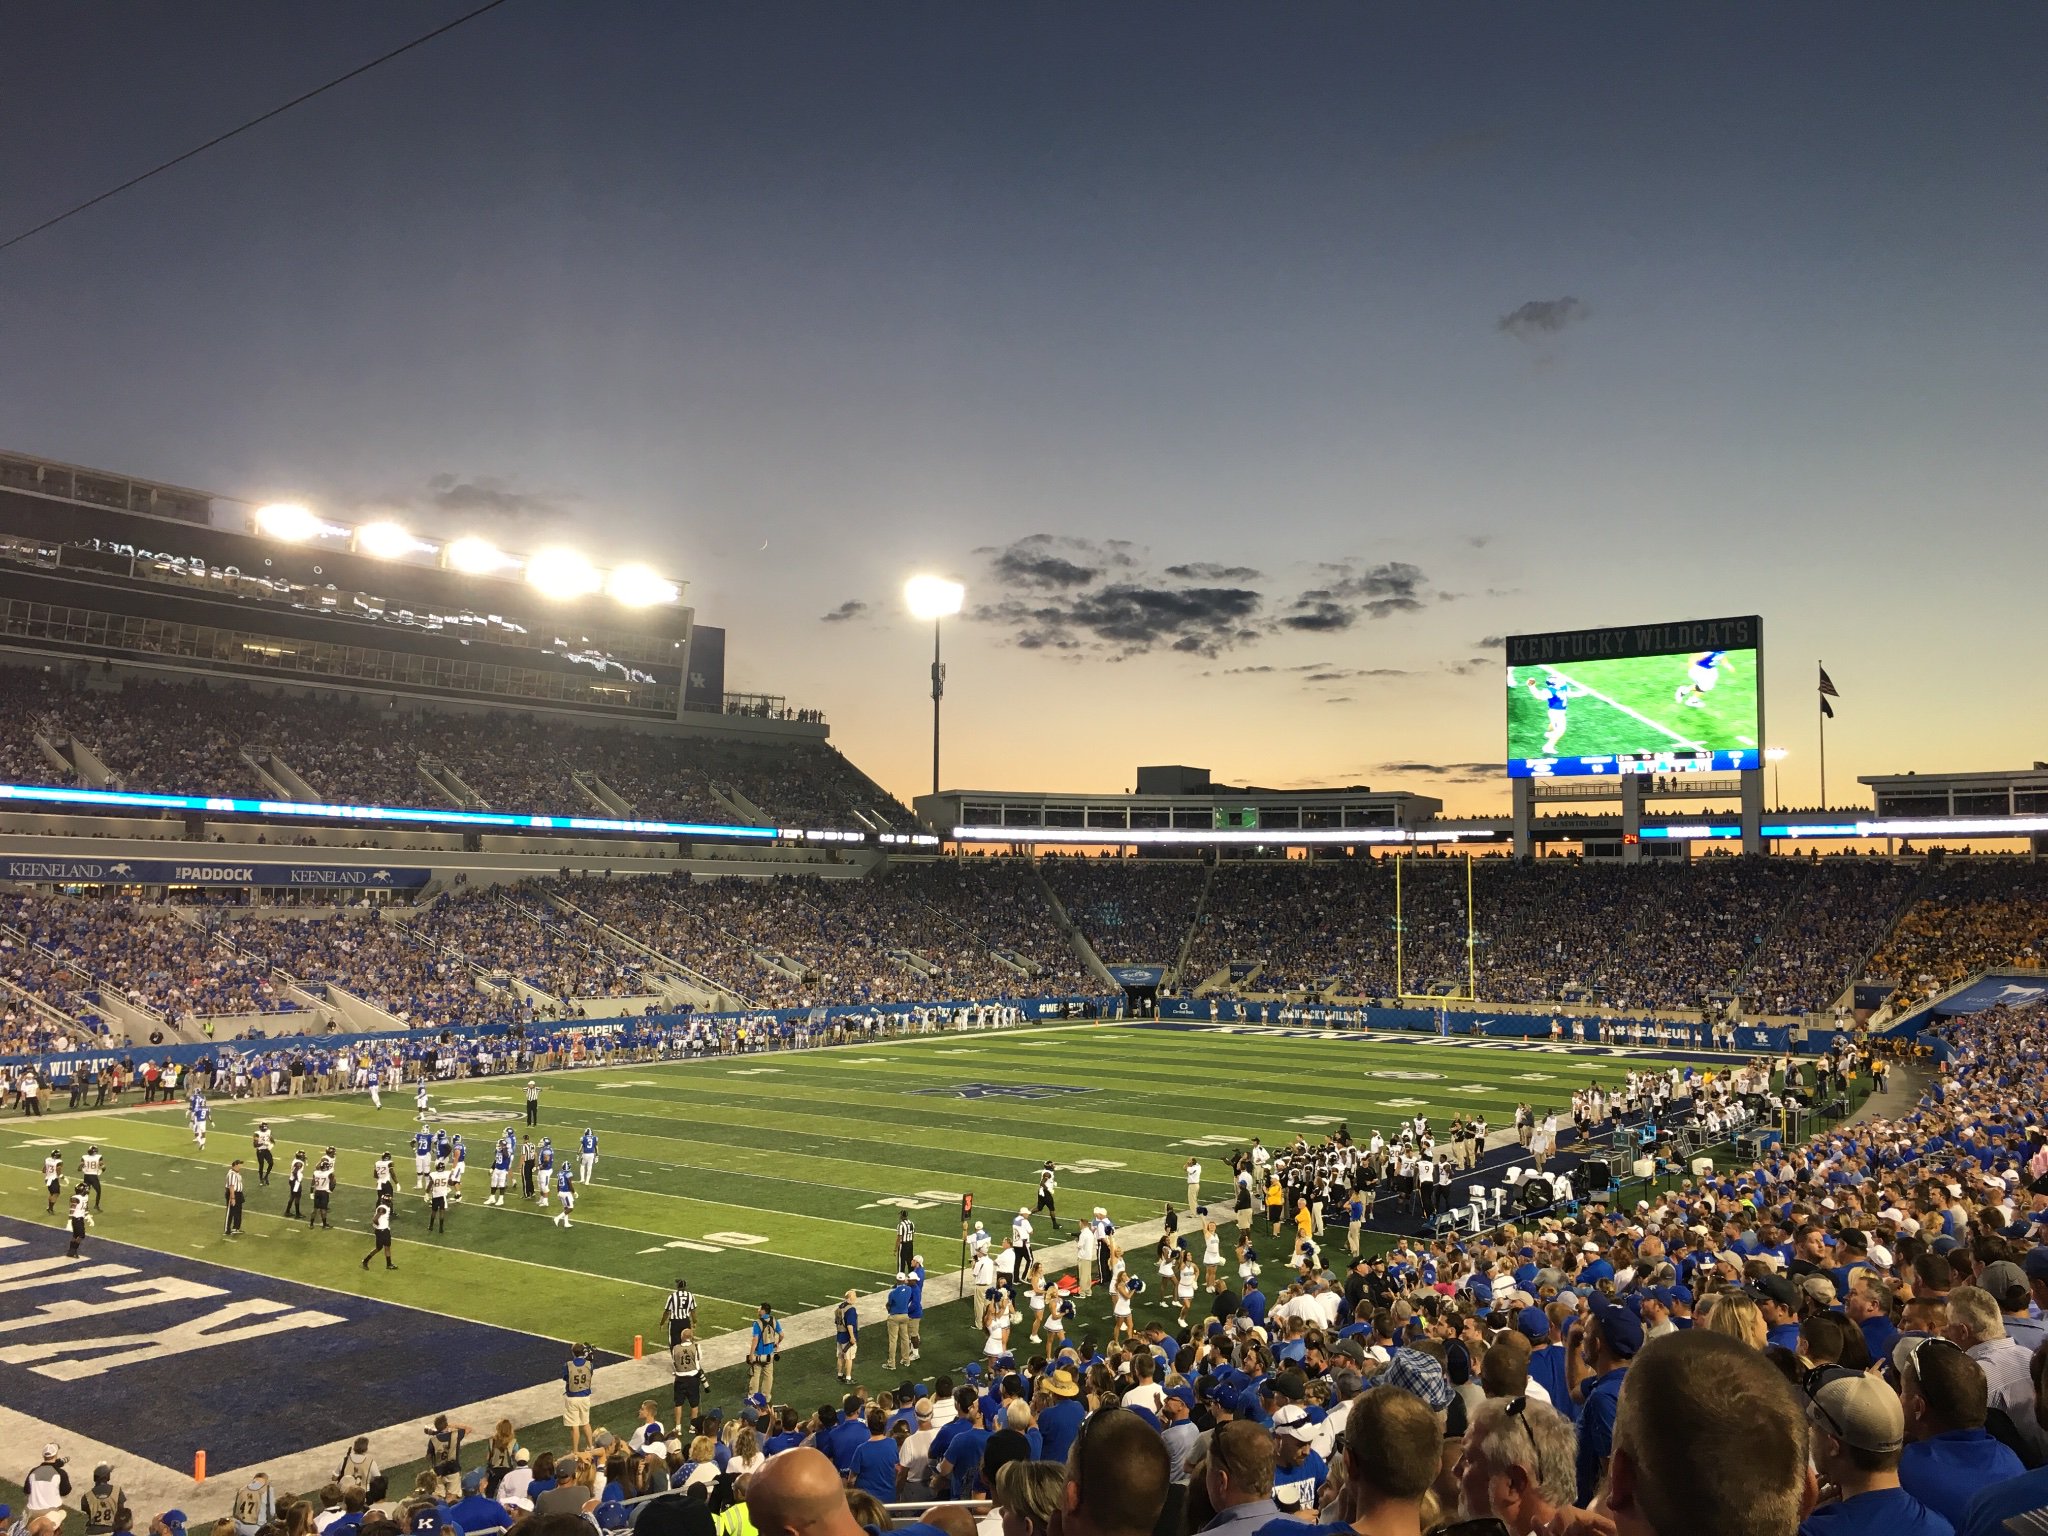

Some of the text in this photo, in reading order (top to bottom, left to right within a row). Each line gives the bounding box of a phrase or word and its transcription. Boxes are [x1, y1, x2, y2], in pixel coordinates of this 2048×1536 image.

[1513, 620, 1749, 661] KENTUCKY WILDCATS
[1590, 819, 1609, 827] FIELD
[1643, 817, 1739, 826] COMMONWEALTH STADIUM
[1624, 835, 1637, 844] 24
[9, 862, 103, 878] KEENELAND
[181, 867, 253, 881] PADDOCK
[291, 870, 366, 884] KEENELAND
[418, 1140, 428, 1150] 73
[587, 1138, 593, 1149] 3
[1424, 1165, 1430, 1174] 9
[434, 1179, 447, 1187] 85
[876, 1190, 963, 1210] 20
[964, 1195, 972, 1211] 3
[663, 1231, 770, 1253] 10
[679, 1296, 688, 1309] F
[680, 1355, 691, 1366] 15
[573, 1374, 587, 1385] 59
[239, 1501, 255, 1515] 47
[94, 1509, 111, 1523] 28
[417, 1518, 434, 1529] K
